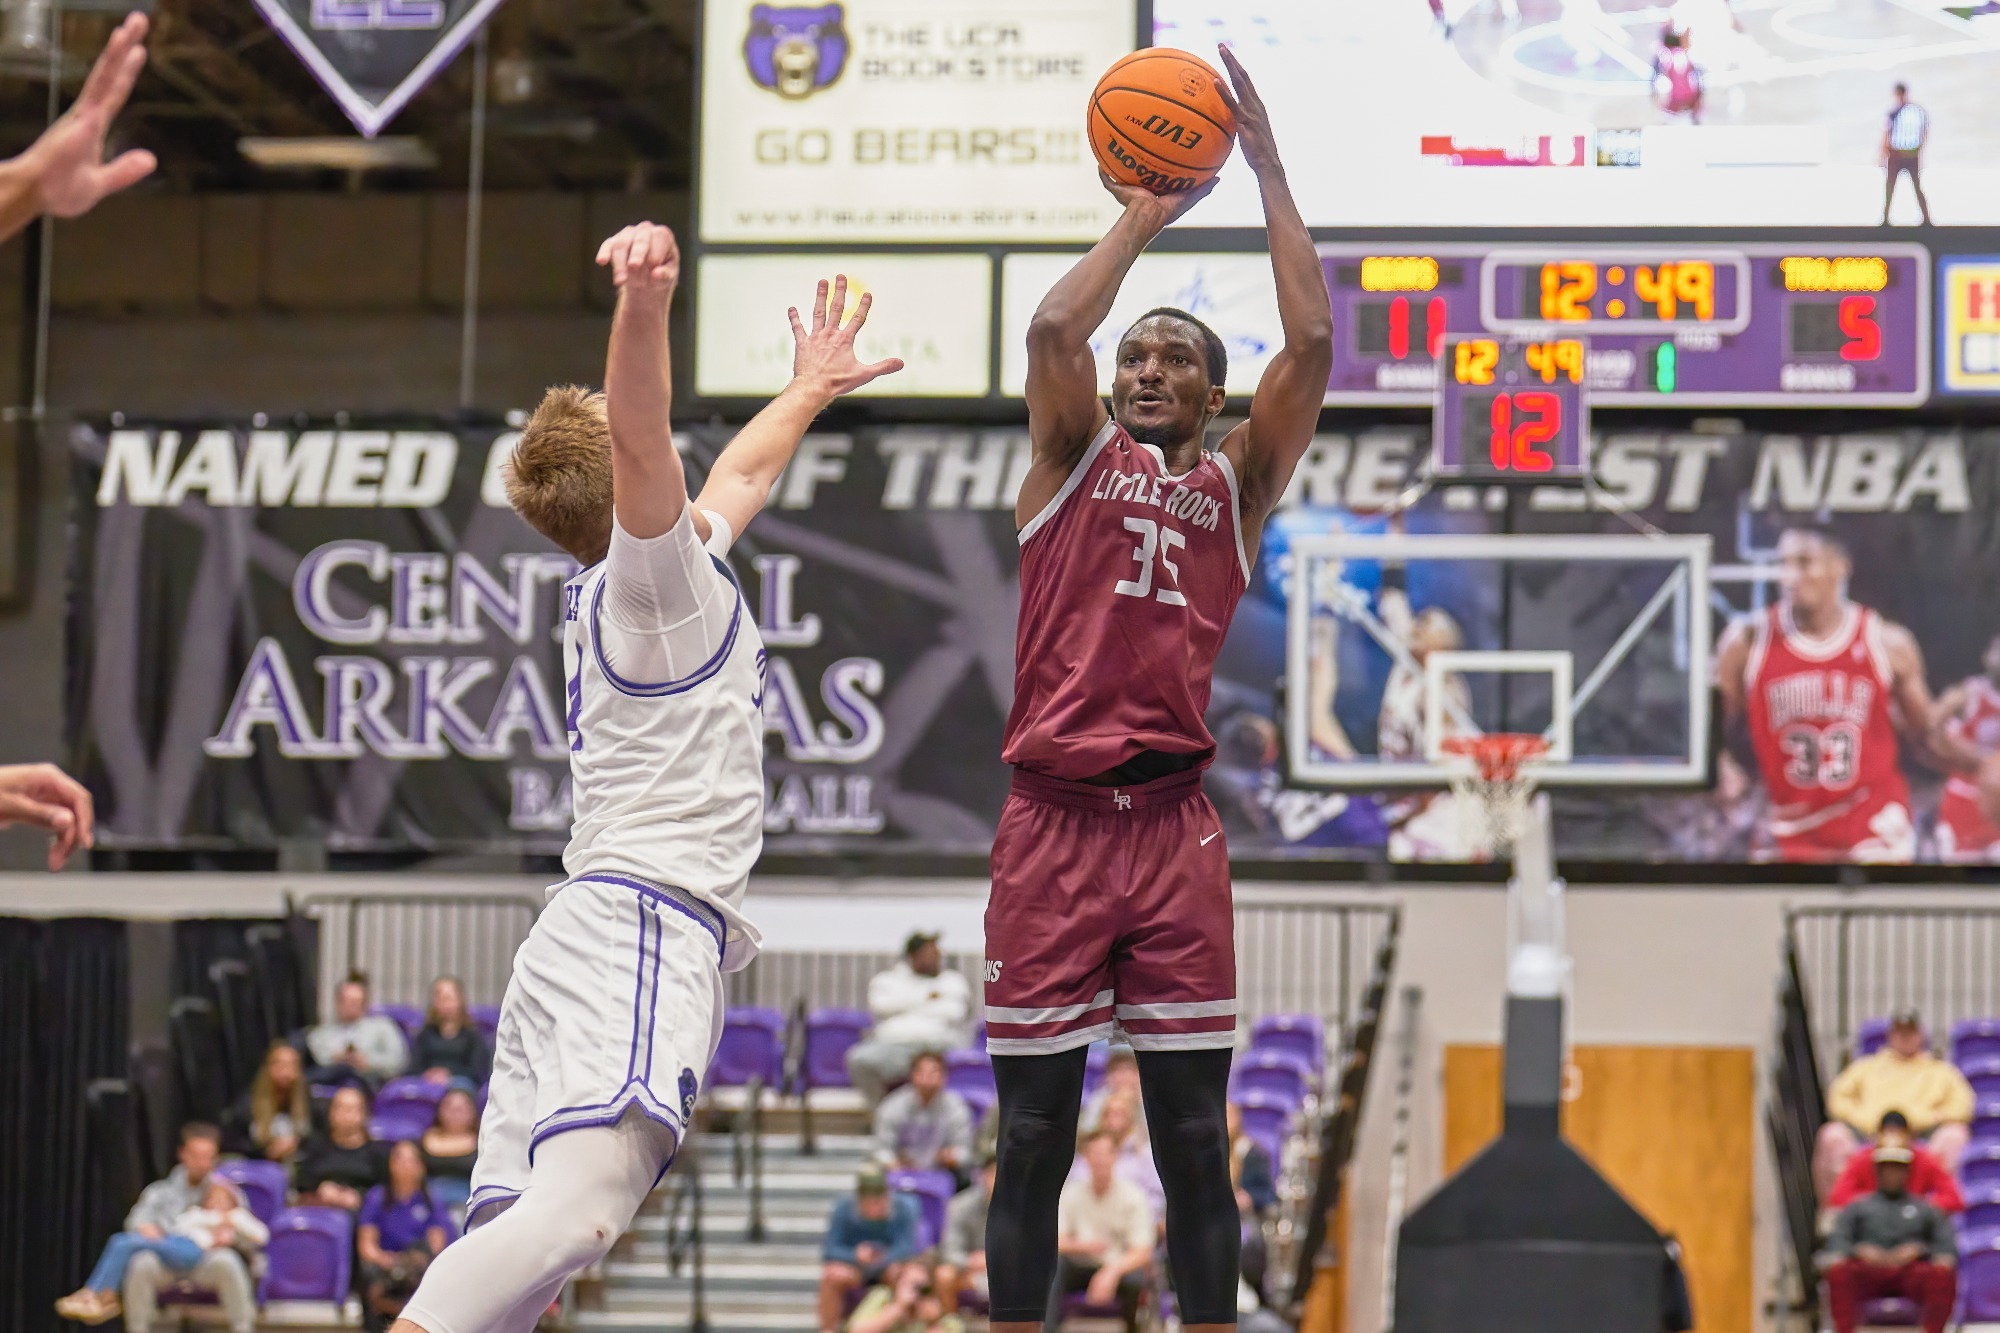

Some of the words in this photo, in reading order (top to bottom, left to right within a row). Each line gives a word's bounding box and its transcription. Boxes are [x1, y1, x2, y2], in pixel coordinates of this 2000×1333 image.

[754, 128, 831, 165] GO
[853, 128, 1082, 165] BEARS!!!
[1125, 114, 1143, 127] NXT
[1142, 114, 1203, 150] EVO
[1107, 134, 1197, 193] Wilson
[1540, 259, 1715, 324] 12:49
[1388, 295, 1447, 360] 11
[1838, 295, 1882, 361] 5
[1656, 341, 1677, 394] 1
[1490, 391, 1562, 472] 12
[95, 430, 460, 508] NAMED
[1750, 436, 1973, 514] NBA
[1091, 468, 1164, 509] LITTLE
[1165, 485, 1225, 534] ROCK
[1113, 516, 1188, 607] 35
[203, 637, 886, 764] ARKAAS
